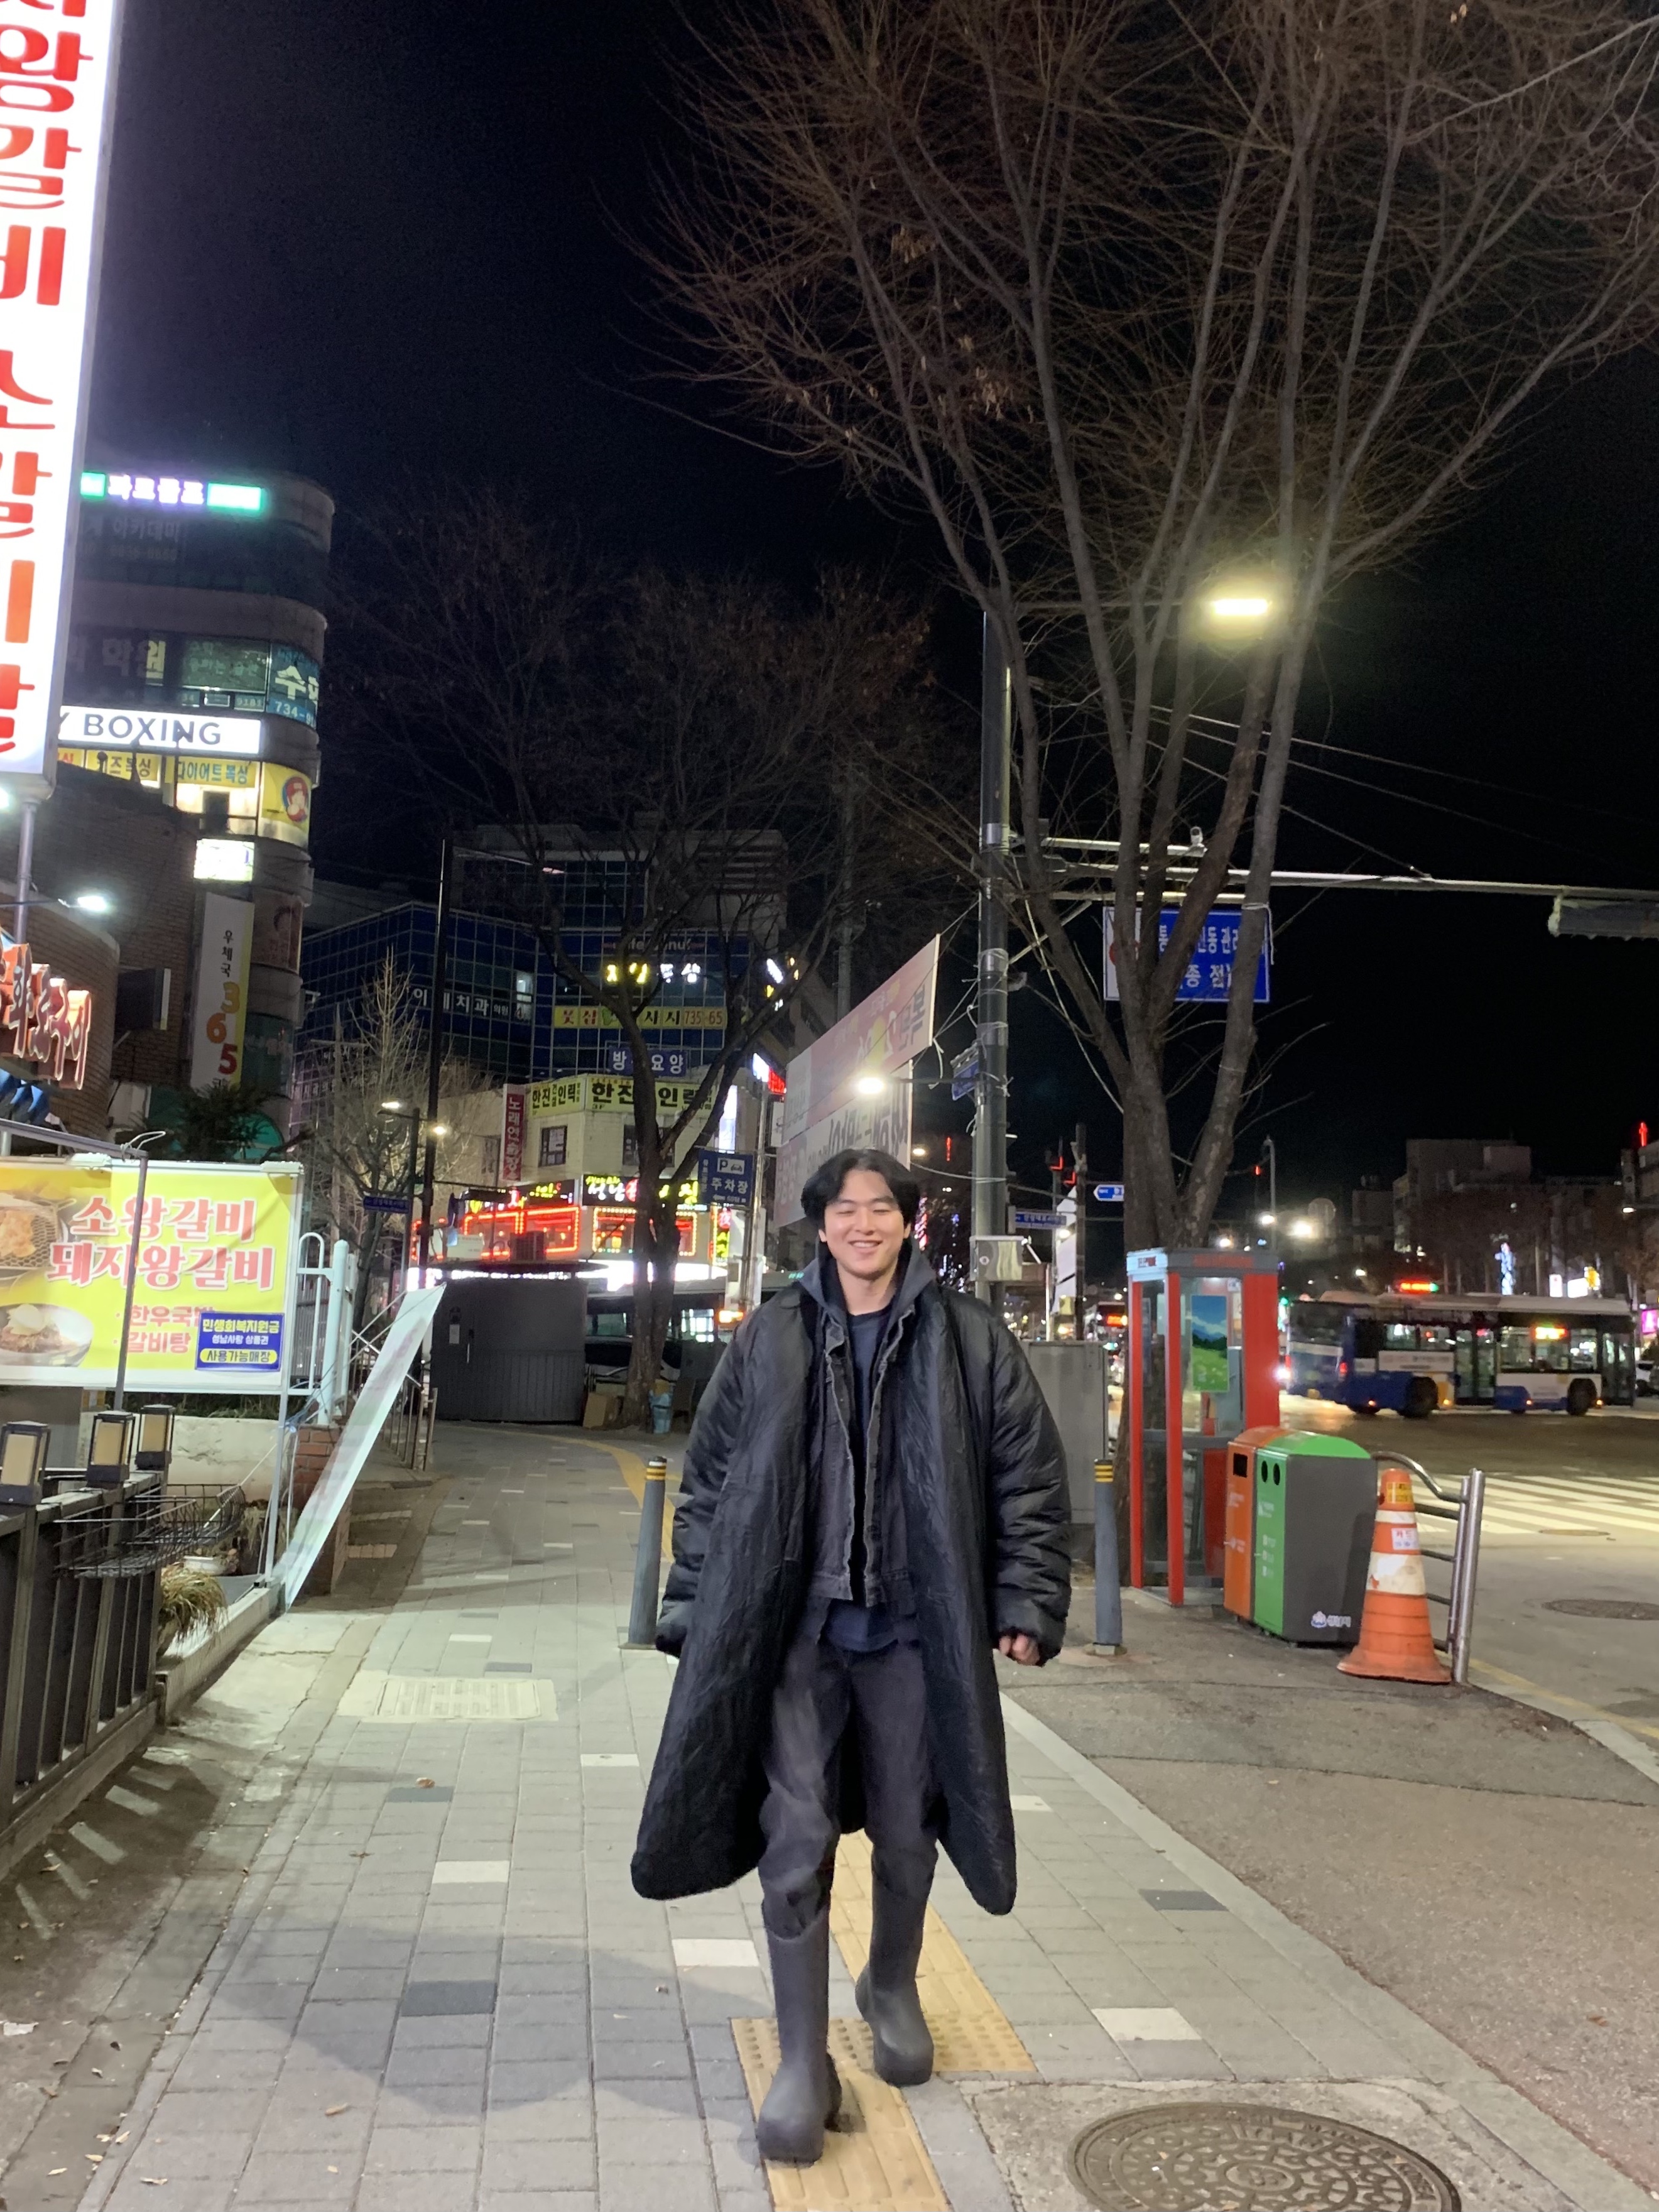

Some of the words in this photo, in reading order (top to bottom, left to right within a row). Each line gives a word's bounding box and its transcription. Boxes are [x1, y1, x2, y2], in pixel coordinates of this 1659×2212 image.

[0, 0, 93, 306] 왕갈비
[84, 714, 221, 745] BOXING
[220, 929, 234, 978] 우체국
[413, 988, 489, 1016] 이치과
[206, 980, 241, 1076] 365
[612, 1050, 684, 1074] 방요양
[711, 1177, 749, 1194] 주차장
[70, 1196, 256, 1243] 소왕갈비
[47, 1241, 276, 1292] 돼지왕갈비
[202, 1319, 280, 1334] 민생회복지원금
[212, 1334, 244, 1345] 성남사랑
[127, 1332, 192, 1354] 갈비탕
[206, 1350, 271, 1363] 사용가능매장
